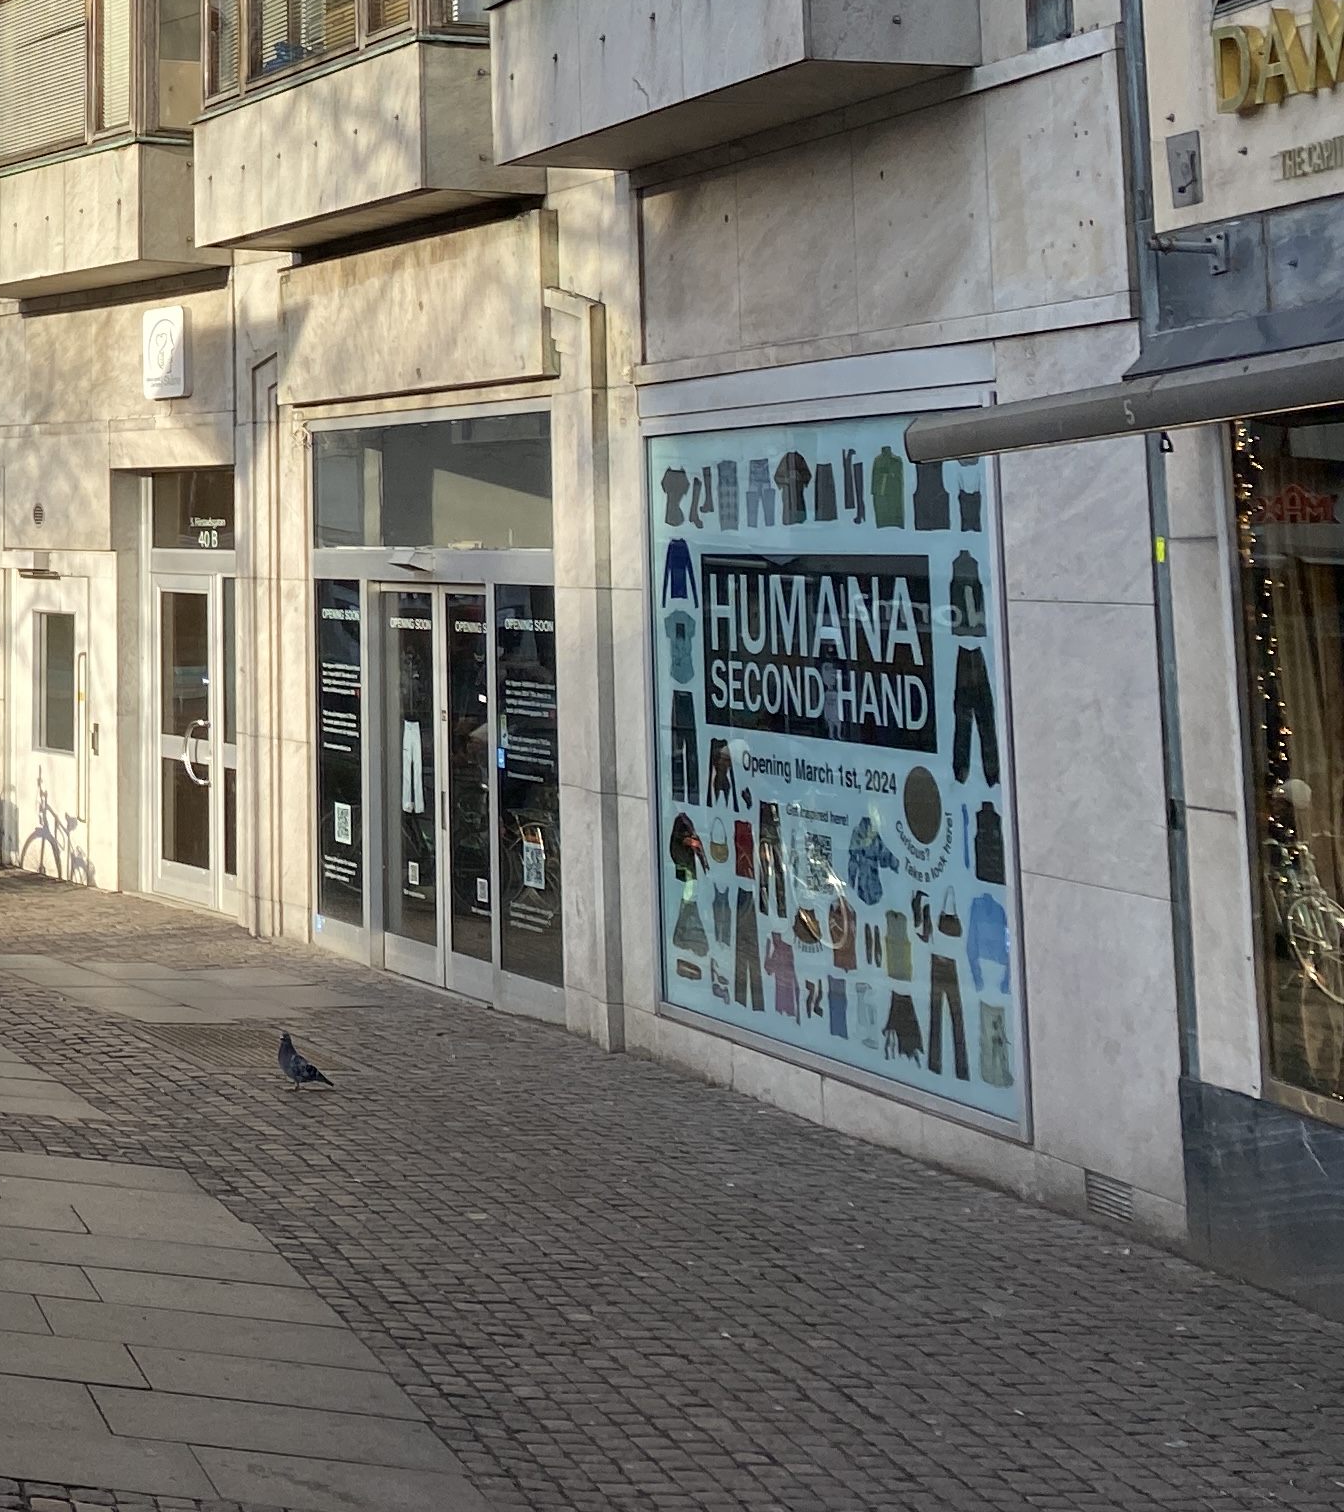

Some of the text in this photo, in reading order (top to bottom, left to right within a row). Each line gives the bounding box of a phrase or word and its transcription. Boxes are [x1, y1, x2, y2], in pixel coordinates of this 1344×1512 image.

[198, 530, 218, 548] 40 B
[322, 608, 360, 621] OPENING SOON
[710, 573, 924, 666] HUMANA
[390, 617, 432, 631] OPENING SOON
[455, 620, 482, 634] OPENING
[504, 617, 533, 632] OPENING
[534, 619, 554, 632] SOON
[711, 659, 928, 730] SECOND HAND
[742, 750, 898, 795] Opening March 1st, 2024
[830, 811, 850, 826] here!
[895, 820, 930, 862] Curious?
[904, 811, 954, 883] Take a look here!
